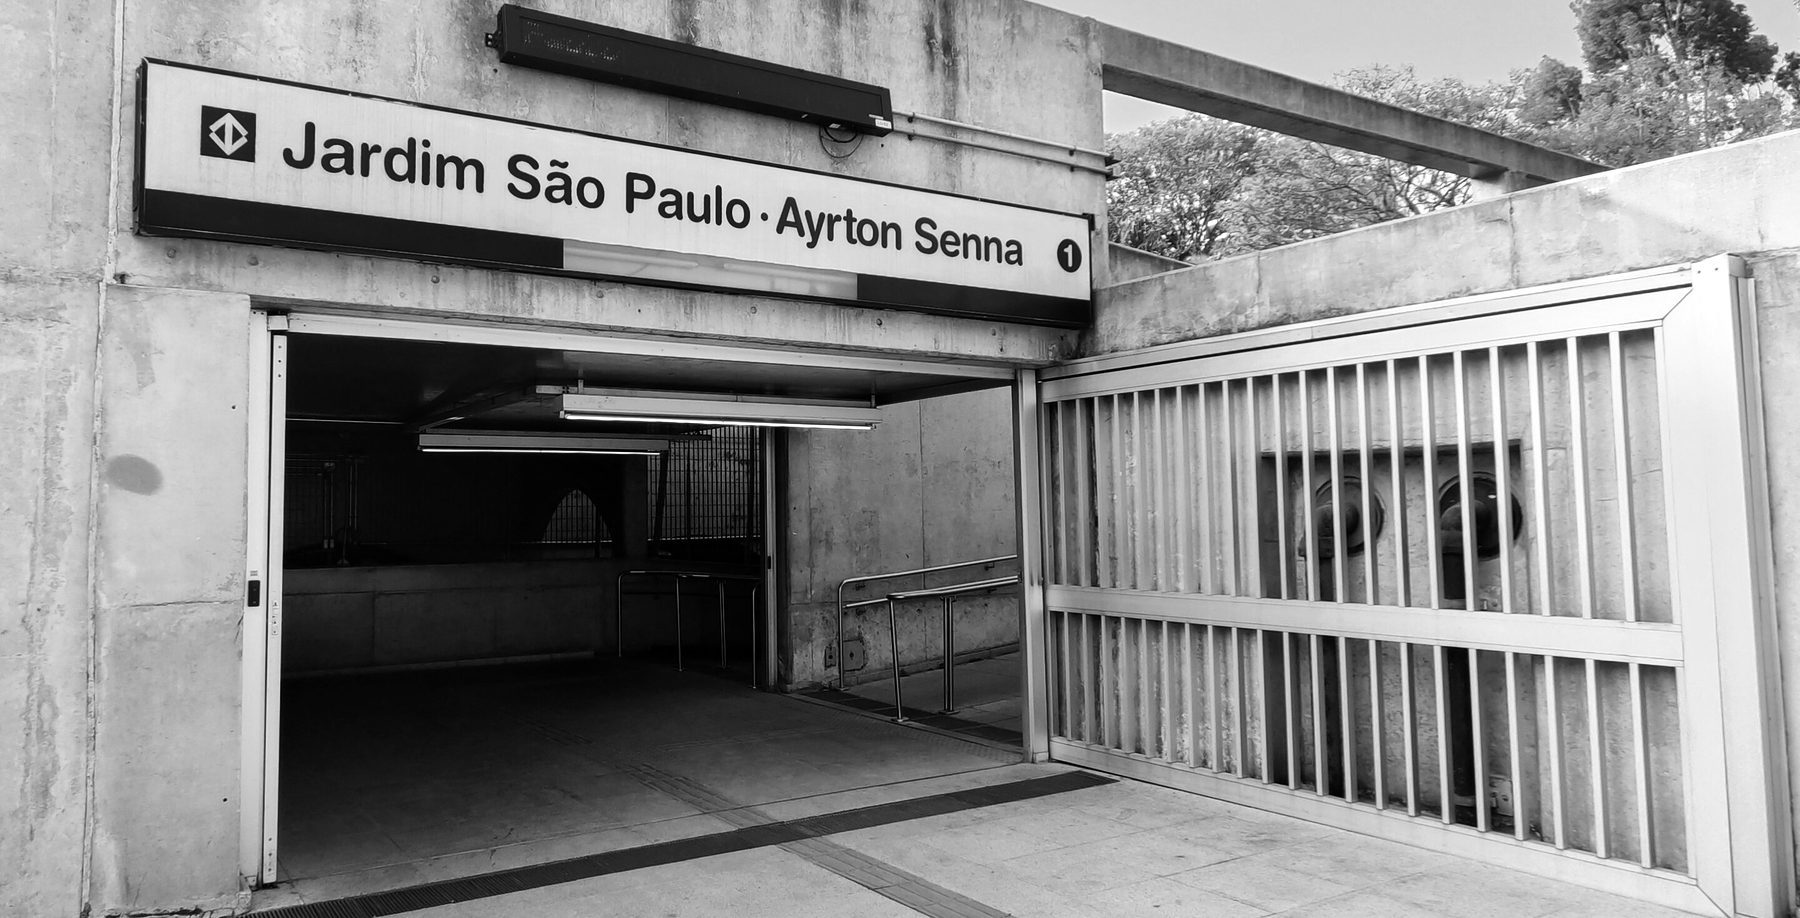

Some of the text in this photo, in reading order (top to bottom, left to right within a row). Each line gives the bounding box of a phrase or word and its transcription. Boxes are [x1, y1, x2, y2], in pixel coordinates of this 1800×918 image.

[282, 121, 485, 194] Jardim
[507, 154, 605, 209] São
[625, 171, 751, 229] Paulo
[775, 196, 902, 251] Ayrton
[914, 216, 1024, 275] Senna
